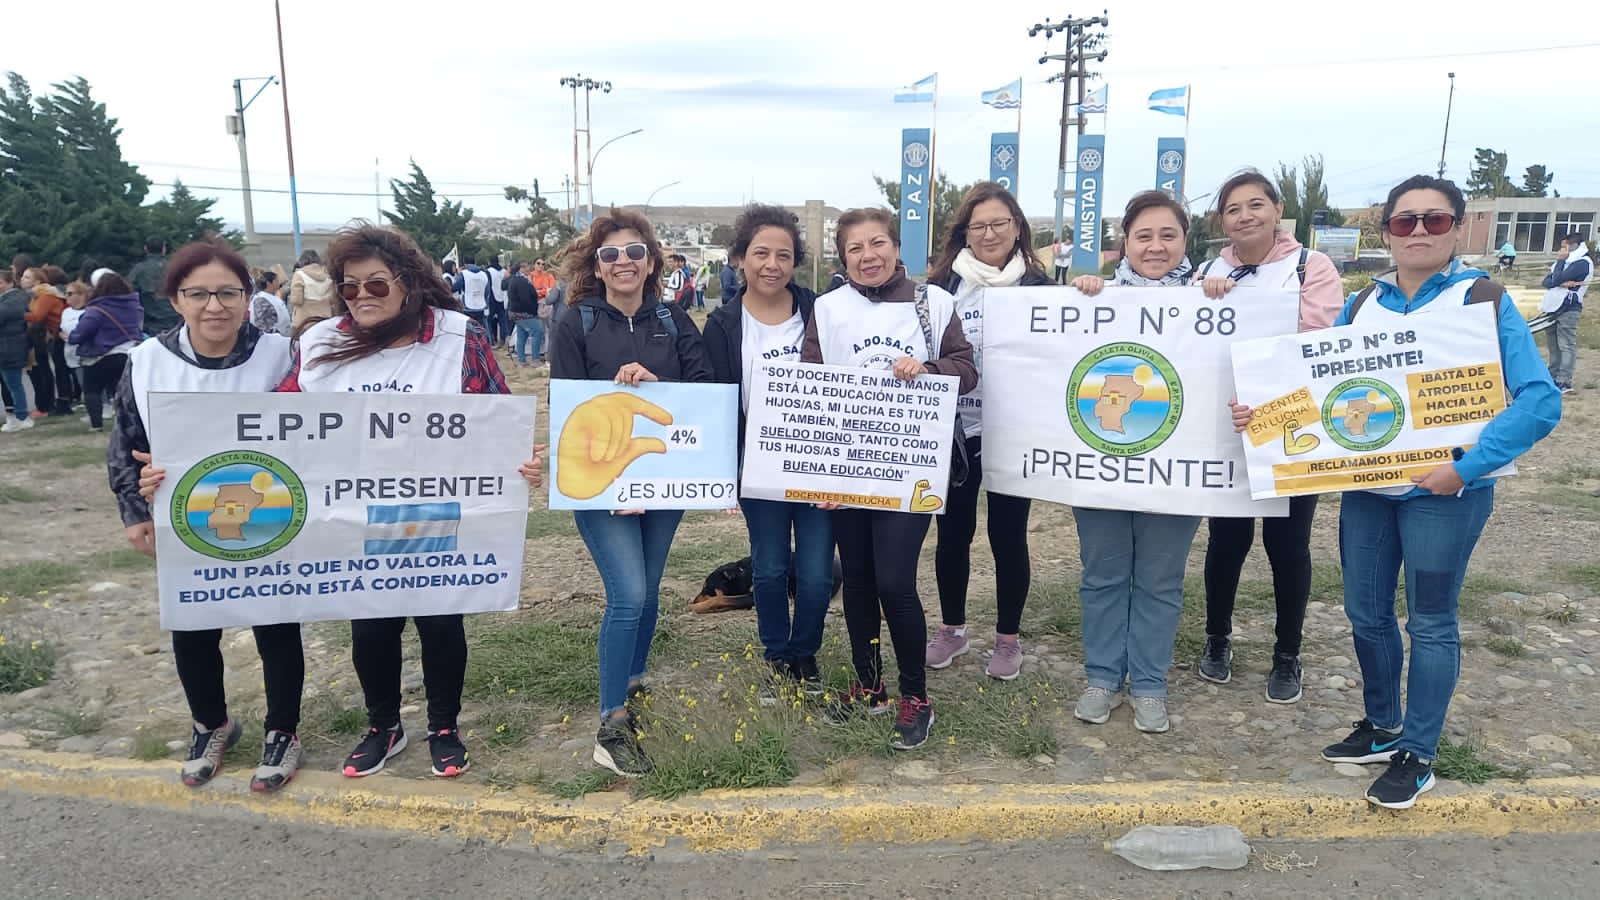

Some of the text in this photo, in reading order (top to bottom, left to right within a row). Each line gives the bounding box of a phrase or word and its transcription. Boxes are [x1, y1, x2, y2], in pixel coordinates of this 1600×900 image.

[906, 172, 922, 221] PAZ
[1080, 177, 1096, 252] AMISTAD
[1030, 306, 1115, 333] E.P.P
[1194, 307, 1236, 335] 88
[1301, 338, 1352, 358] E.P.P
[1394, 330, 1416, 345] 88
[1311, 350, 1423, 378] ¡PRESENTE!
[1421, 366, 1485, 383] ¡BASTA DE
[796, 369, 857, 386] DOCENTE,
[861, 375, 877, 386] EN
[881, 377, 901, 389] MIS
[905, 379, 949, 393] MANOS
[1418, 380, 1493, 398] ATROPELLO
[768, 381, 940, 407] ESTÁ LA EDUCACIÓN DE TUS
[1253, 389, 1308, 418] OCENTES
[1426, 395, 1487, 411] HACIA LA
[765, 396, 939, 421] HIJOS/AS, MI LUCHA ES TUYA
[1424, 409, 1495, 425] DOCENCIA!
[236, 412, 343, 441] E.P.P
[425, 413, 466, 439] 88
[781, 412, 921, 434] TAMBIÉN, MEREZCO UN
[1251, 422, 1268, 434] EN
[670, 429, 697, 444] 4%
[760, 425, 939, 450] SUELDO DIGNO, TANTO COMO
[758, 440, 937, 465] TUS HIJOS/AS MERECEN UNA
[1307, 449, 1449, 473] ¡RECLAMAMOS SUELDOS
[783, 460, 827, 473] BUENA
[1022, 448, 1235, 489] ¡PRESENTE!
[1353, 470, 1403, 483] DIGNOS!
[324, 475, 504, 506] ¡PRESENTE!
[617, 483, 735, 503] ¿ES JUSTO?
[785, 489, 891, 506] DOCENTES EN LUCHA
[244, 560, 291, 578] PAÍS
[297, 560, 342, 577] QUE
[347, 558, 380, 571] NO
[386, 553, 467, 570] VALORA
[473, 553, 497, 566] LA
[179, 580, 312, 603] EDUCACIÓN
[318, 575, 365, 595] ESTÁ
